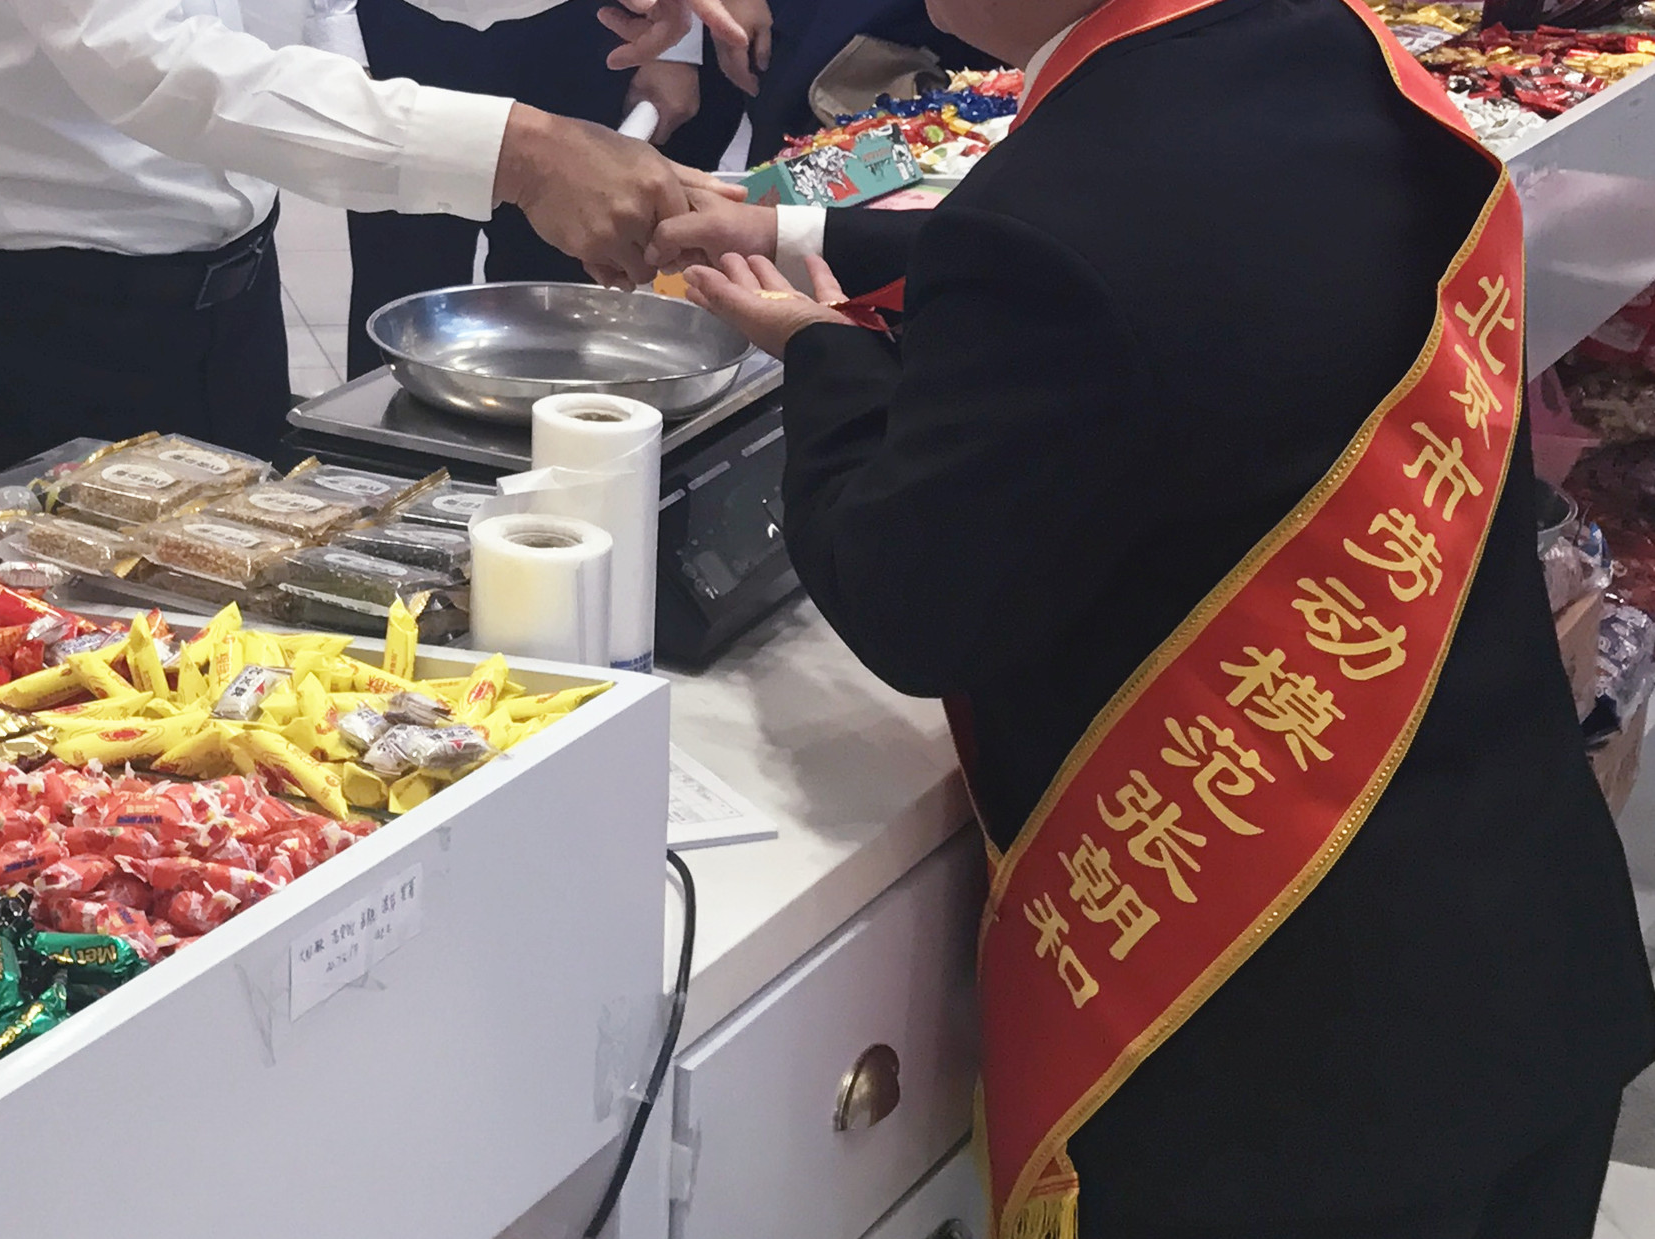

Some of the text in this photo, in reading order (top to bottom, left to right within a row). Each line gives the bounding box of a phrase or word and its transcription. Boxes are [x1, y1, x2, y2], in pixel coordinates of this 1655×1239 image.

[1023, 274, 1516, 1009] 北京市劳动模范张朝和
[76, 943, 118, 967] Met
